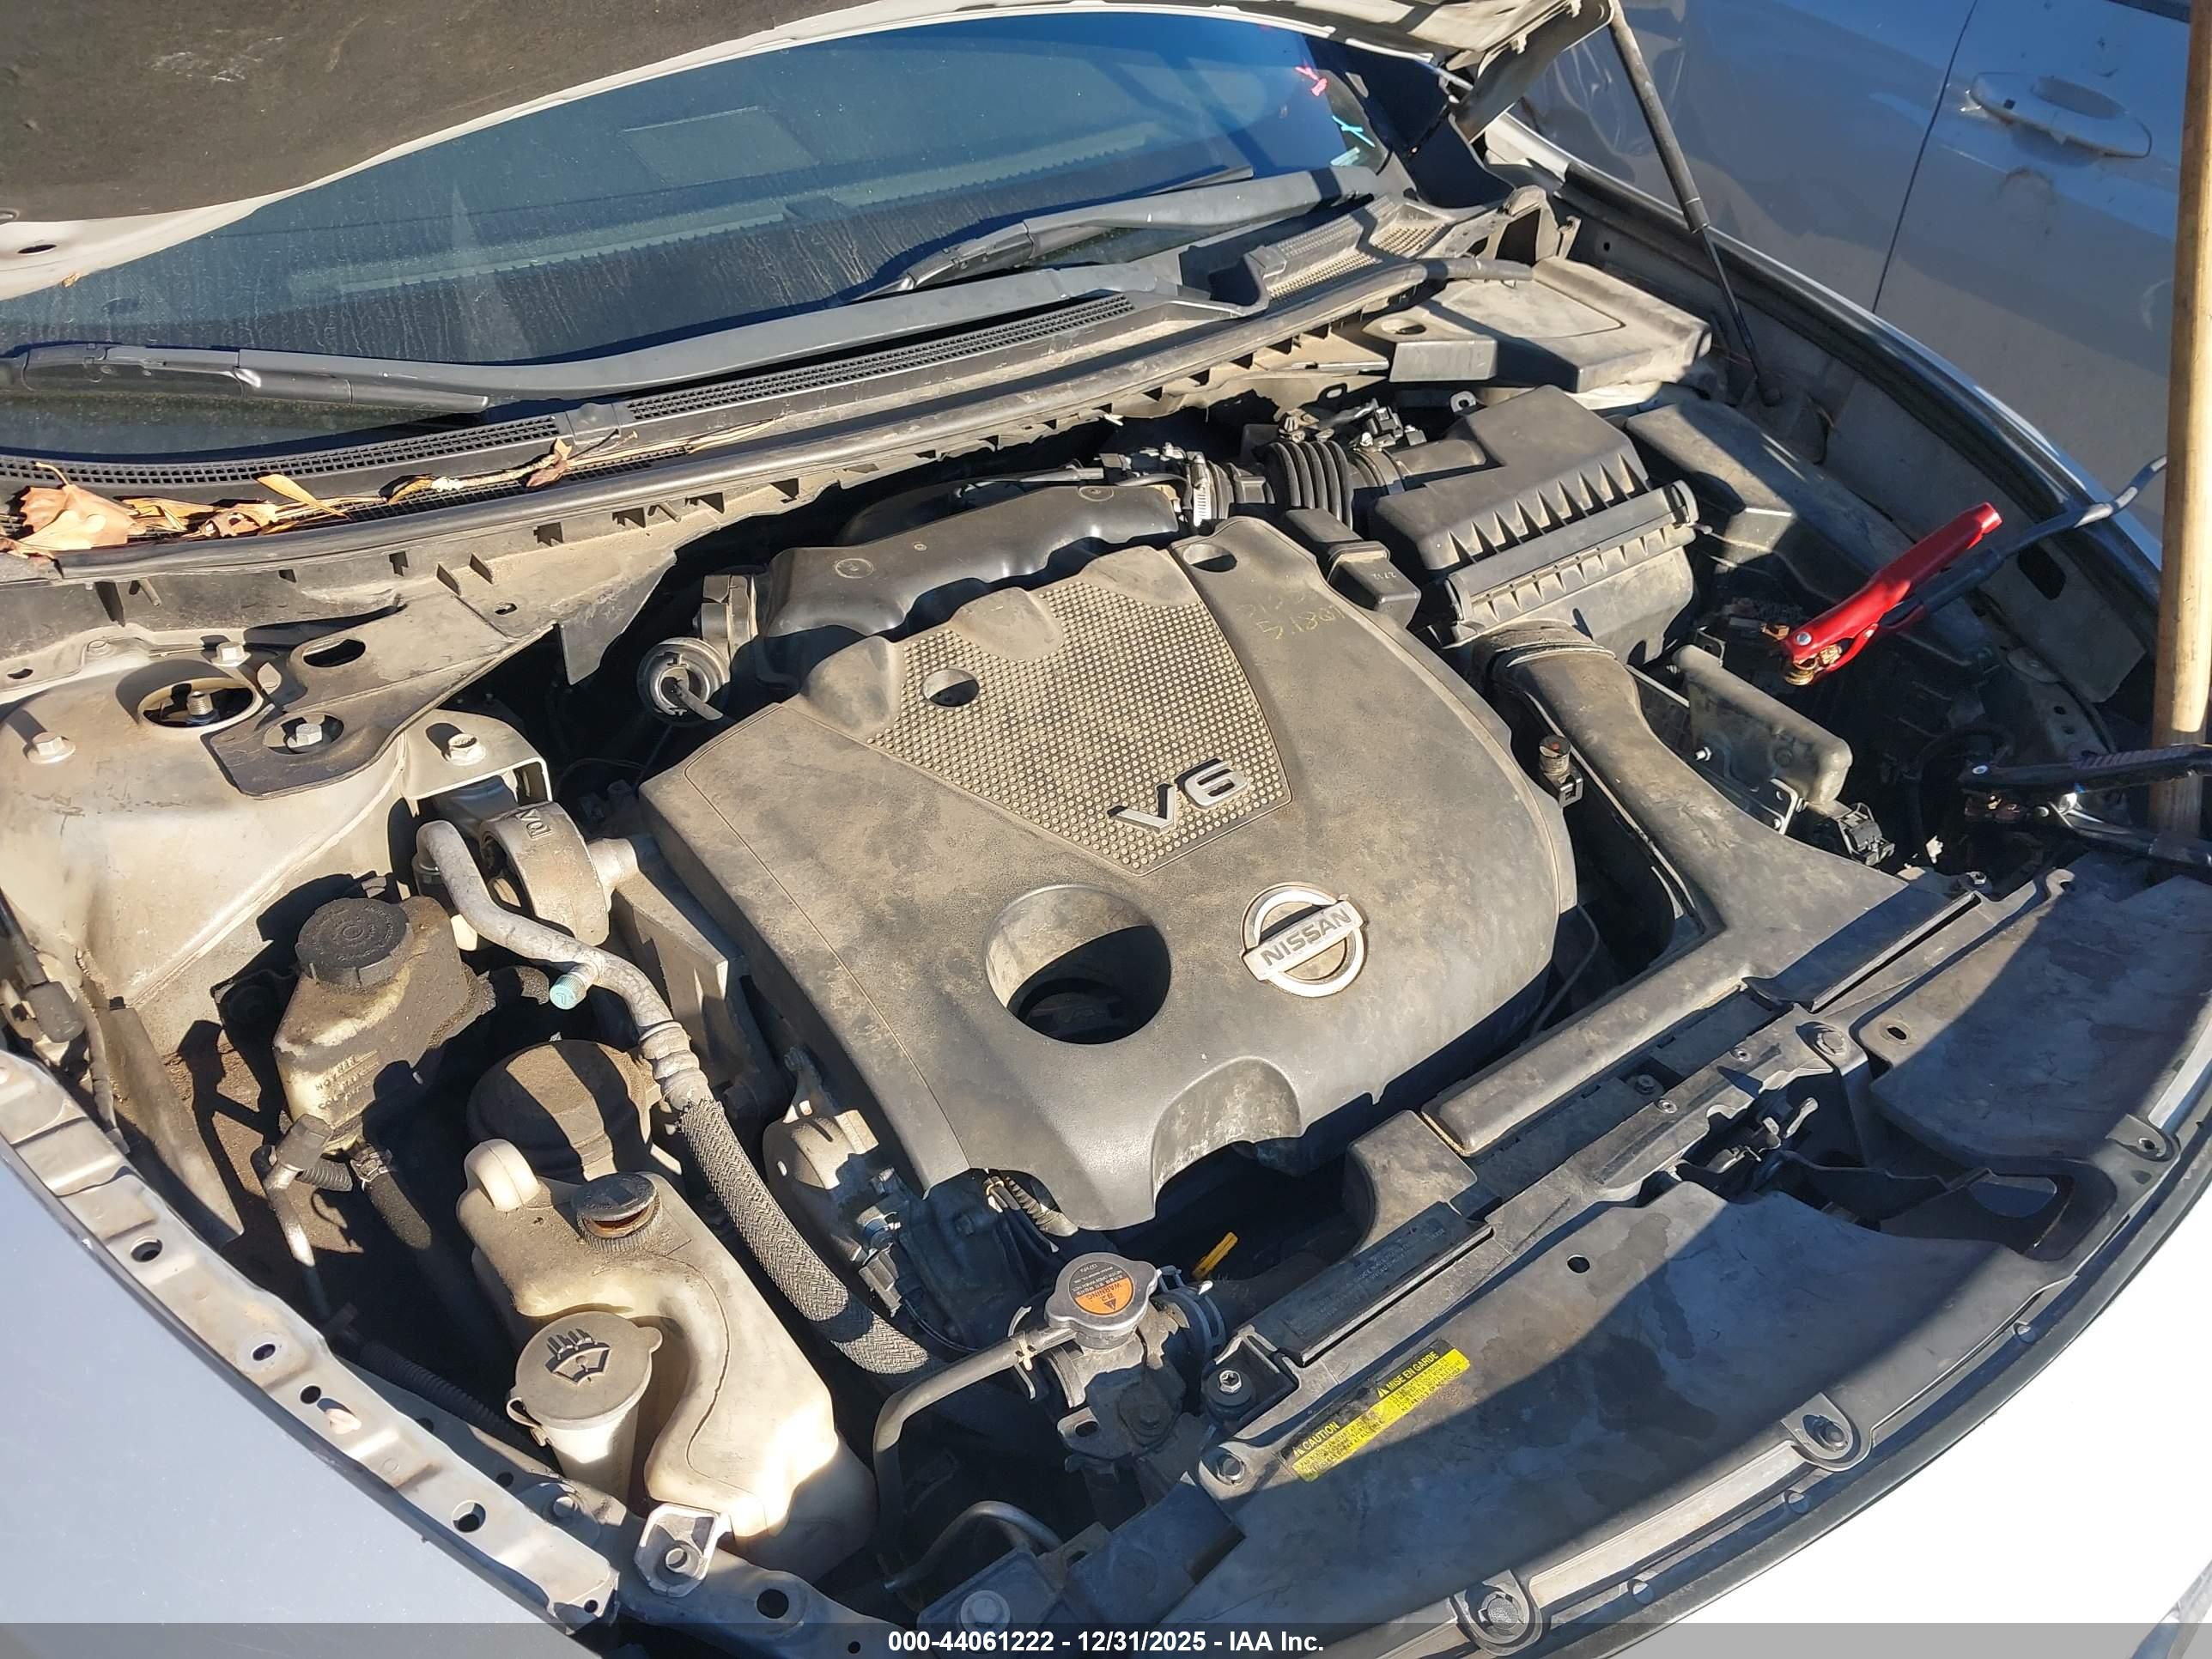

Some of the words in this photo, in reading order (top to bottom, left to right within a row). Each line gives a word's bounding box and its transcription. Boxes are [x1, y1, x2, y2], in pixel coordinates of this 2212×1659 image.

[1109, 759, 1248, 833] V6
[1260, 908, 1352, 966] NISSAN
[1085, 1282, 1121, 1299] WARNING
[1386, 1374, 1406, 1390] MISE
[1402, 1367, 1416, 1378] EN
[1413, 1351, 1439, 1371] GARDE
[1301, 1420, 1340, 1450] CAUTION
